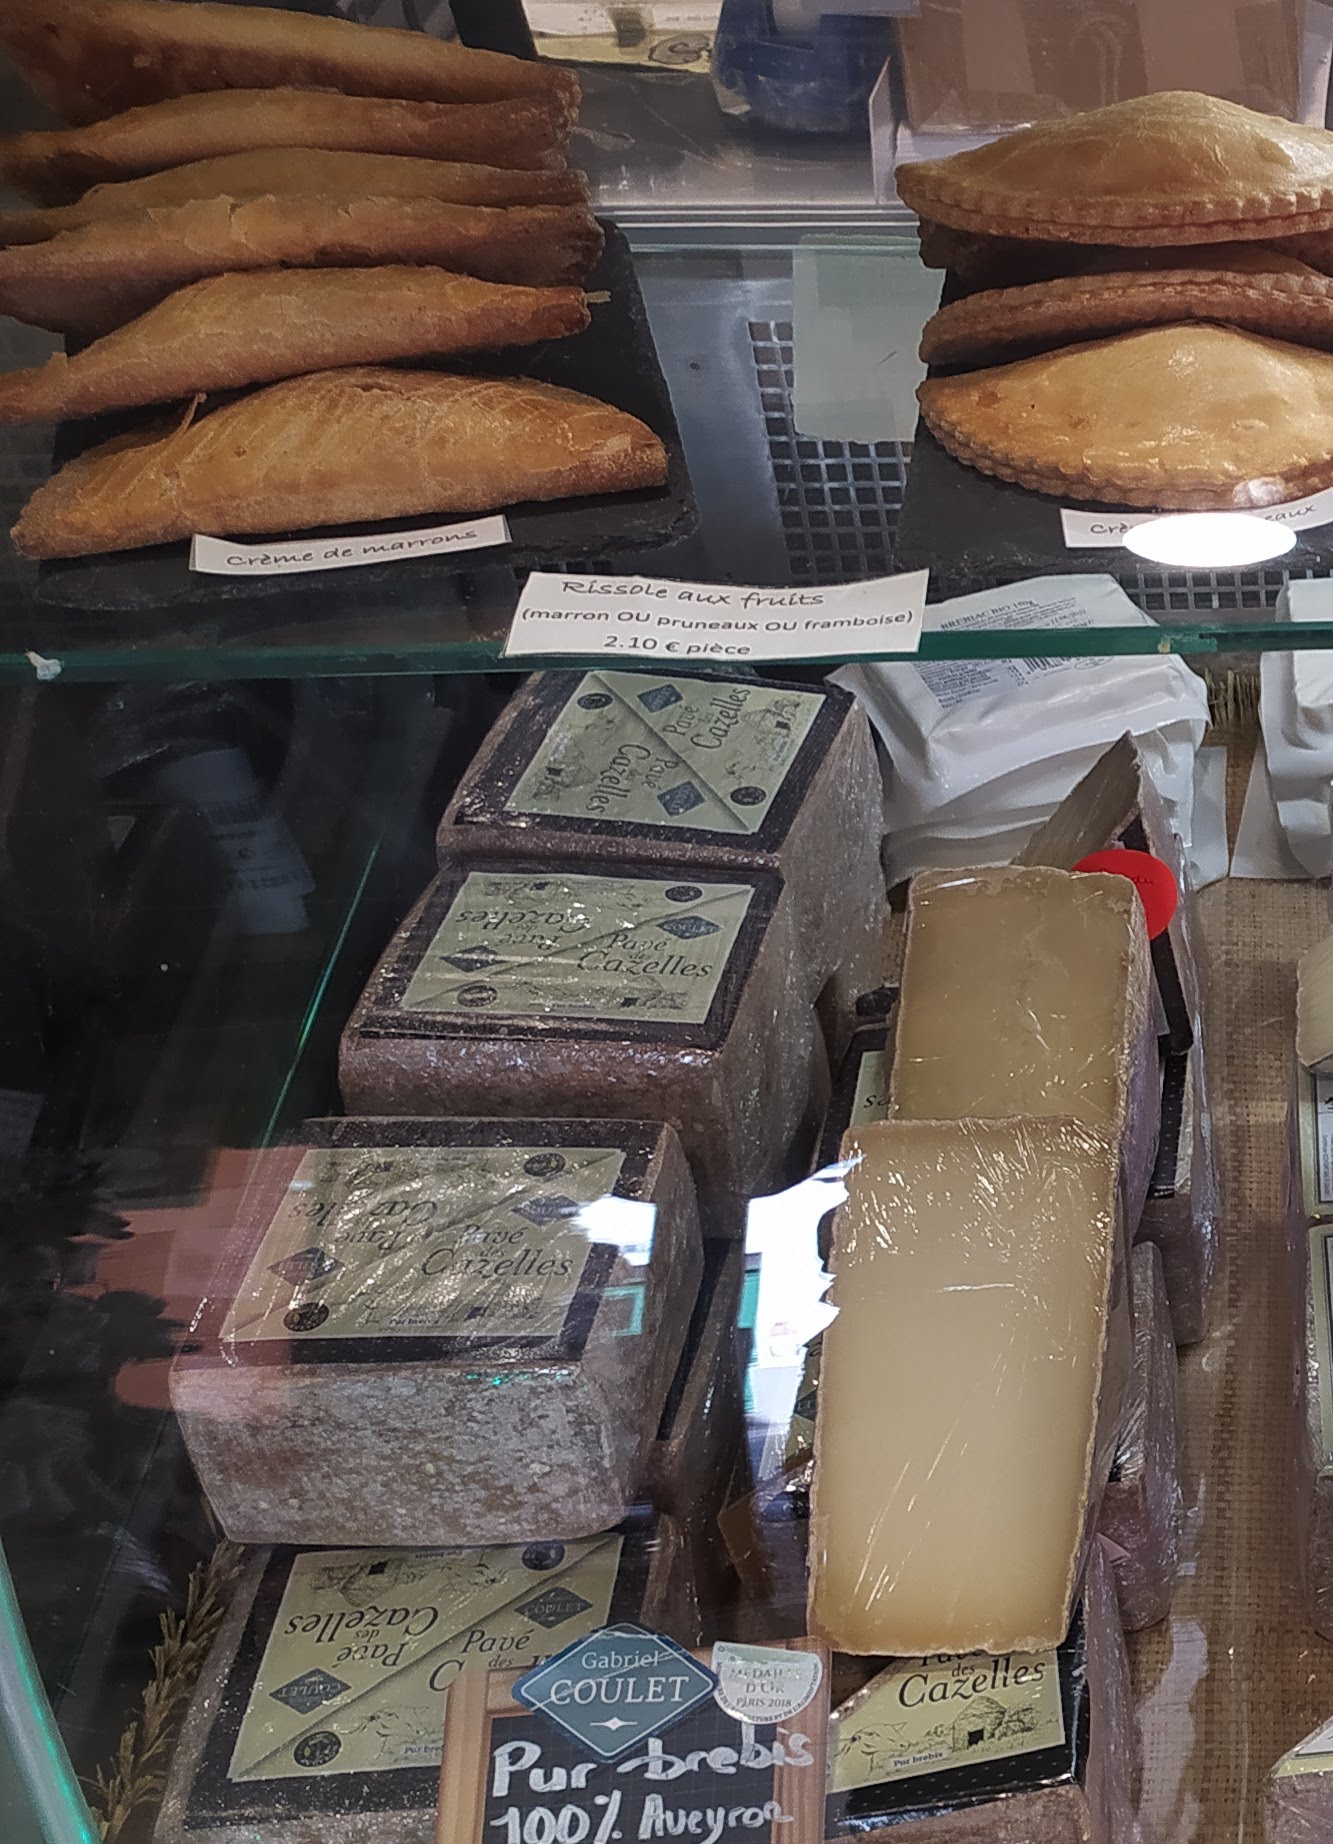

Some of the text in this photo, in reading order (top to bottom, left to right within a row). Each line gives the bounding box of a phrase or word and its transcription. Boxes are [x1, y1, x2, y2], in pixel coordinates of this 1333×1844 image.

[227, 528, 478, 567] Crème de marrons
[562, 578, 824, 610] Rissole aux fruits
[522, 608, 913, 633] (marron OU pruneaux OU framboise)
[603, 634, 752, 656] 2.10 € pièce
[663, 686, 751, 750] Pavé Cazelles
[586, 742, 651, 813] Cazelles
[607, 932, 670, 951] Pavé
[576, 950, 713, 978] Cazelles
[420, 1247, 574, 1279] Cazelles
[284, 1606, 439, 1644] Cazelles
[354, 1629, 381, 1640] des
[336, 1641, 411, 1669] Pavé
[460, 1627, 533, 1657] Pavé
[487, 1655, 514, 1670] des
[581, 1651, 660, 1671] Gabriel
[951, 1662, 976, 1679] des
[549, 1675, 690, 1706] COULET
[898, 1658, 1047, 1709] Cazelles
[768, 1697, 793, 1708] 2018
[491, 1727, 816, 1798] Pur brebis
[489, 1789, 795, 1844] 100% Aveyron
